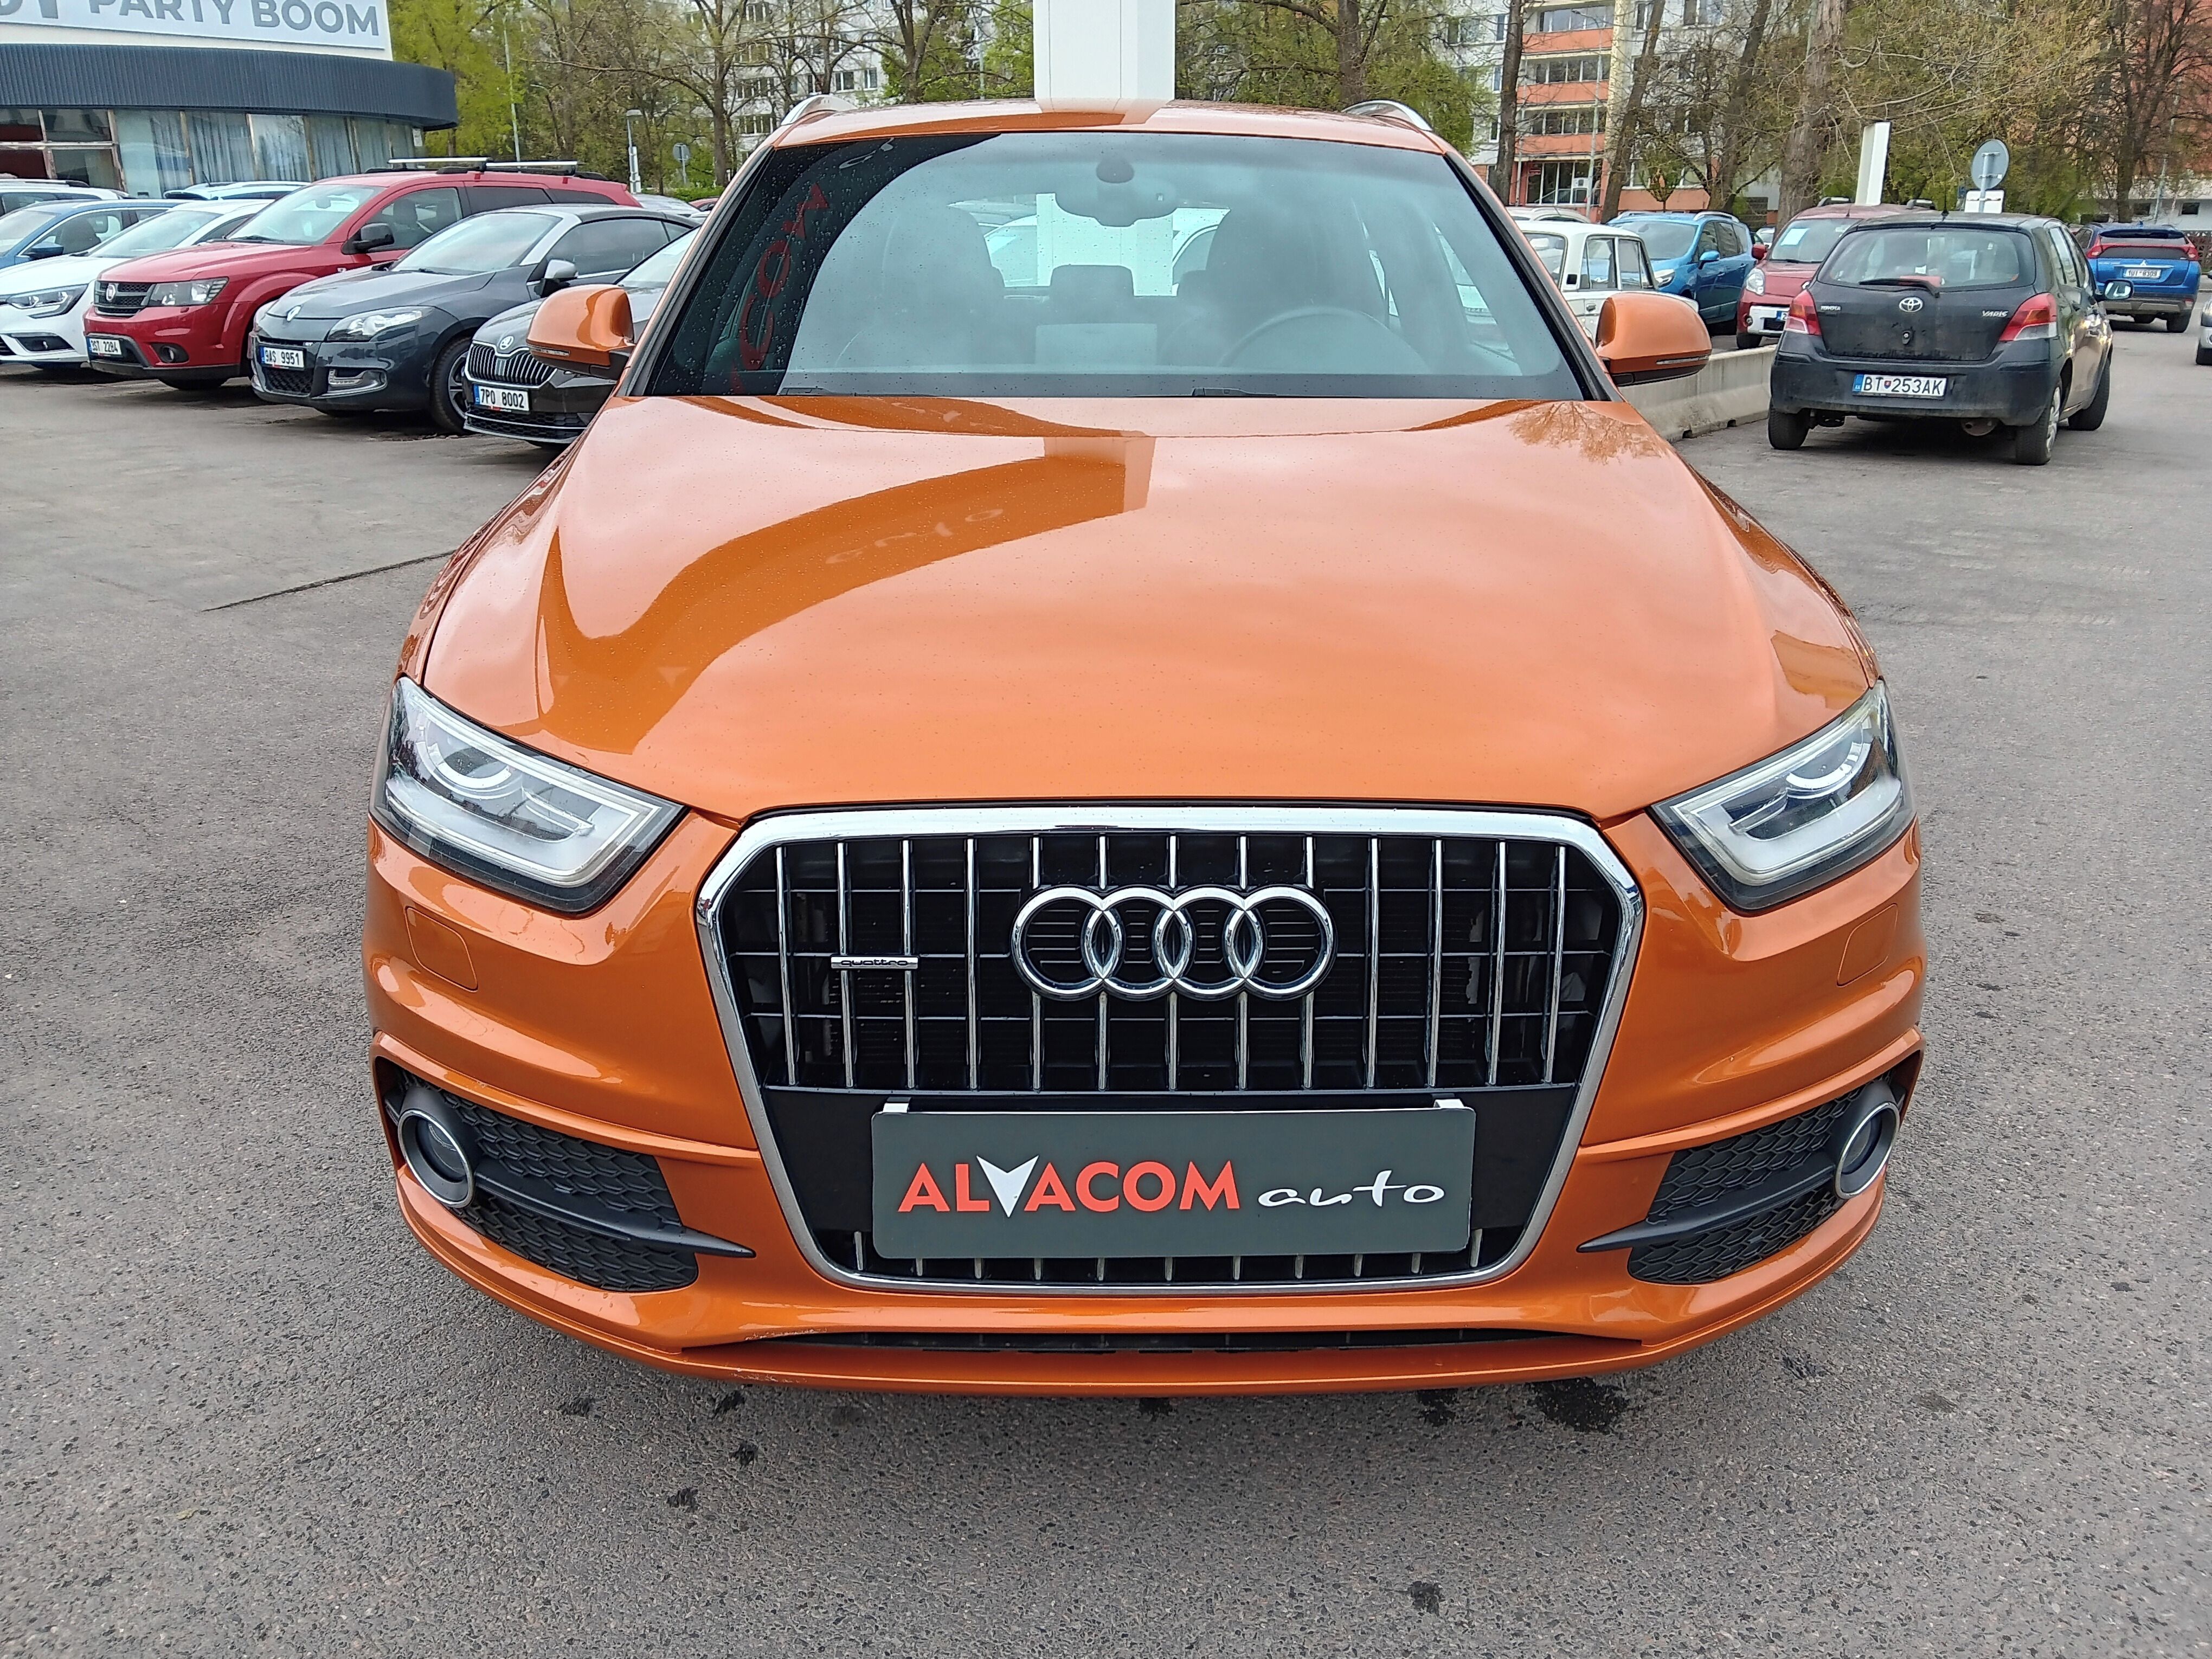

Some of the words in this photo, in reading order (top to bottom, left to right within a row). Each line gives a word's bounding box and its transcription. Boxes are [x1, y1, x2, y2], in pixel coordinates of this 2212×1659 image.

[251, 0, 379, 36] BOOM
[281, 351, 300, 365] 9951
[1863, 376, 1884, 391] BT
[1891, 378, 1943, 395] 253AK
[501, 391, 525, 408] 8002
[841, 959, 908, 967] quattro
[897, 1154, 1240, 1218] ALVACOM
[1258, 1169, 1445, 1207] auto
